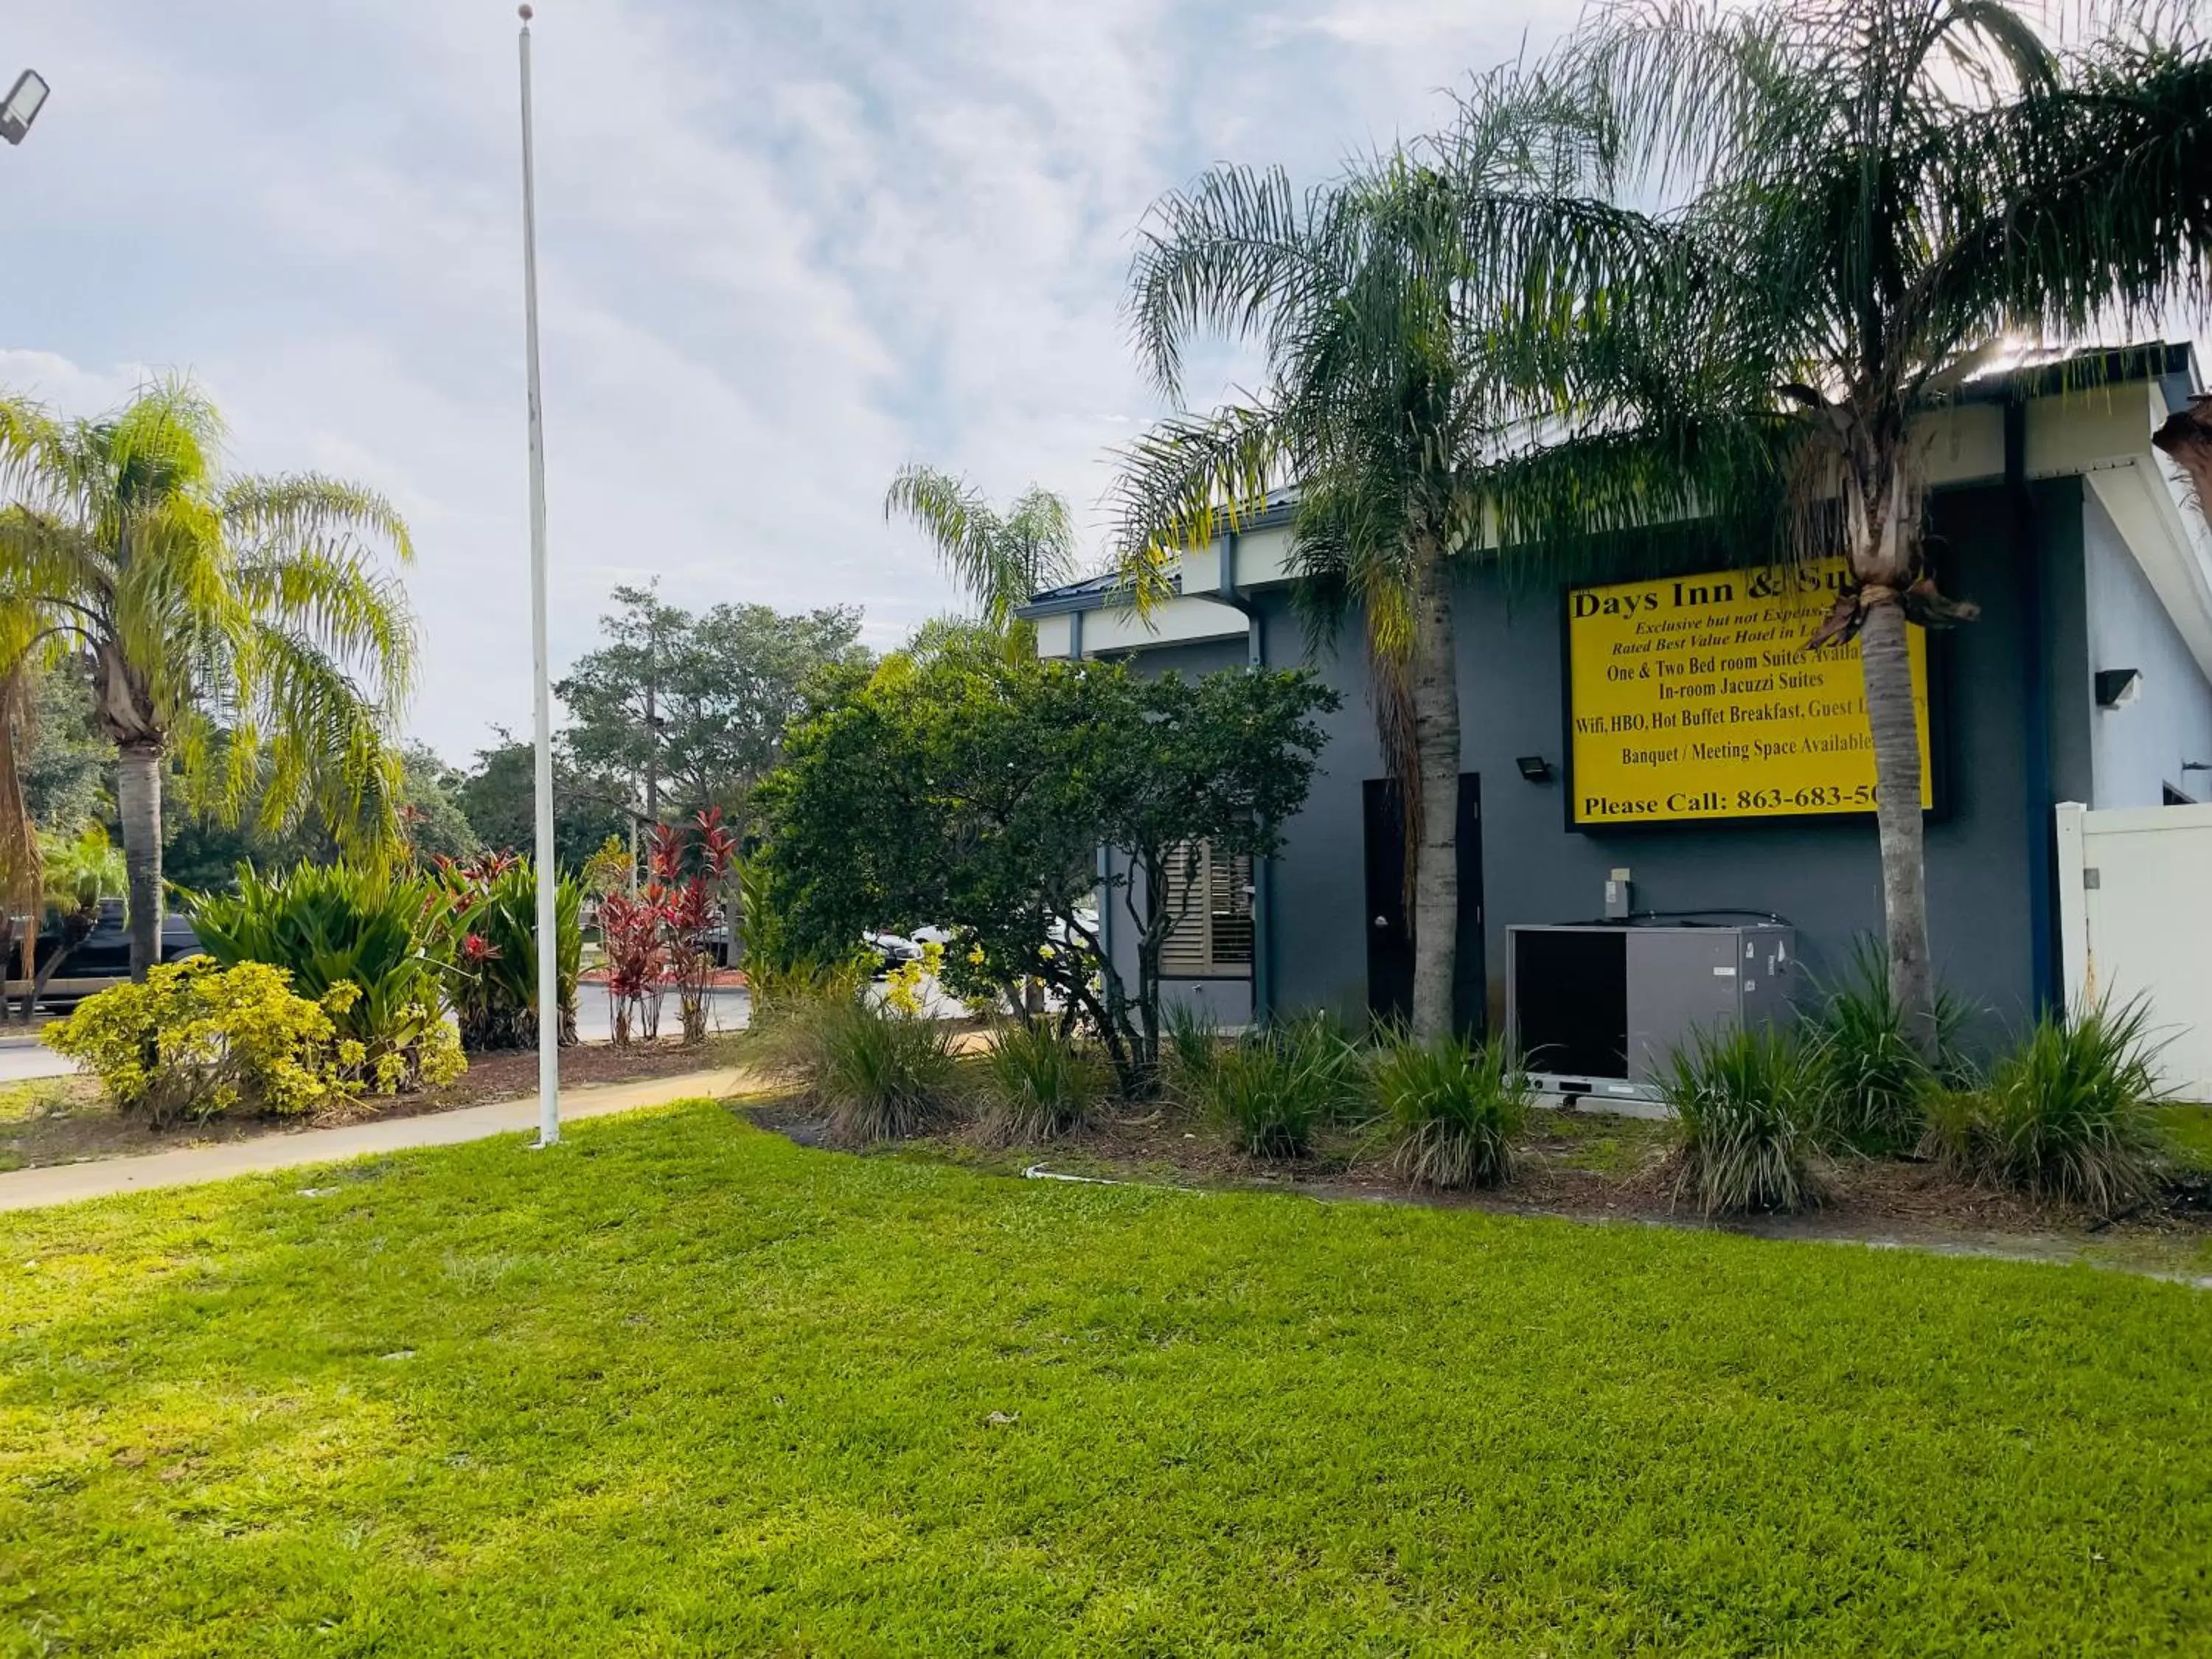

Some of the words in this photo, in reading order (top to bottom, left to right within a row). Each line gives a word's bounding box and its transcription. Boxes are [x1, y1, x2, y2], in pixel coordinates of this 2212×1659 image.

[1573, 592, 1658, 619] Days
[1673, 582, 1733, 607] Inn
[1749, 571, 1781, 598] &
[1635, 617, 1703, 635] Exclusive
[1707, 613, 1730, 627] but
[1735, 611, 1758, 624] not
[1763, 603, 1826, 622] Expensi
[1612, 639, 1652, 655] Rated
[1656, 638, 1686, 651] Best
[1691, 633, 1730, 647] Value
[1735, 627, 1775, 644] Hotel
[1779, 627, 1794, 639] in
[1607, 664, 1635, 682] One
[1639, 662, 1650, 679] &
[1655, 659, 1684, 678] Two
[1689, 655, 1715, 675] Bed
[1720, 655, 1757, 672] room
[1762, 647, 1806, 667] Suites
[1812, 641, 1861, 663] Availa
[1659, 683, 1716, 700] In-room
[1720, 672, 1774, 695] Jacuzzi
[1778, 670, 1824, 689] Suites
[1576, 716, 1608, 735] Wifi,
[1611, 712, 1649, 733] HBO,
[1652, 711, 1677, 729] Hot
[1681, 706, 1725, 726] Buffet
[1808, 698, 1852, 717] Guest
[1622, 746, 1678, 768] Banquet
[1681, 744, 1687, 762] /
[1692, 740, 1750, 762] Meeting
[1753, 737, 1797, 761] Space
[1585, 796, 1658, 815] Please
[1666, 791, 1727, 812] Call:
